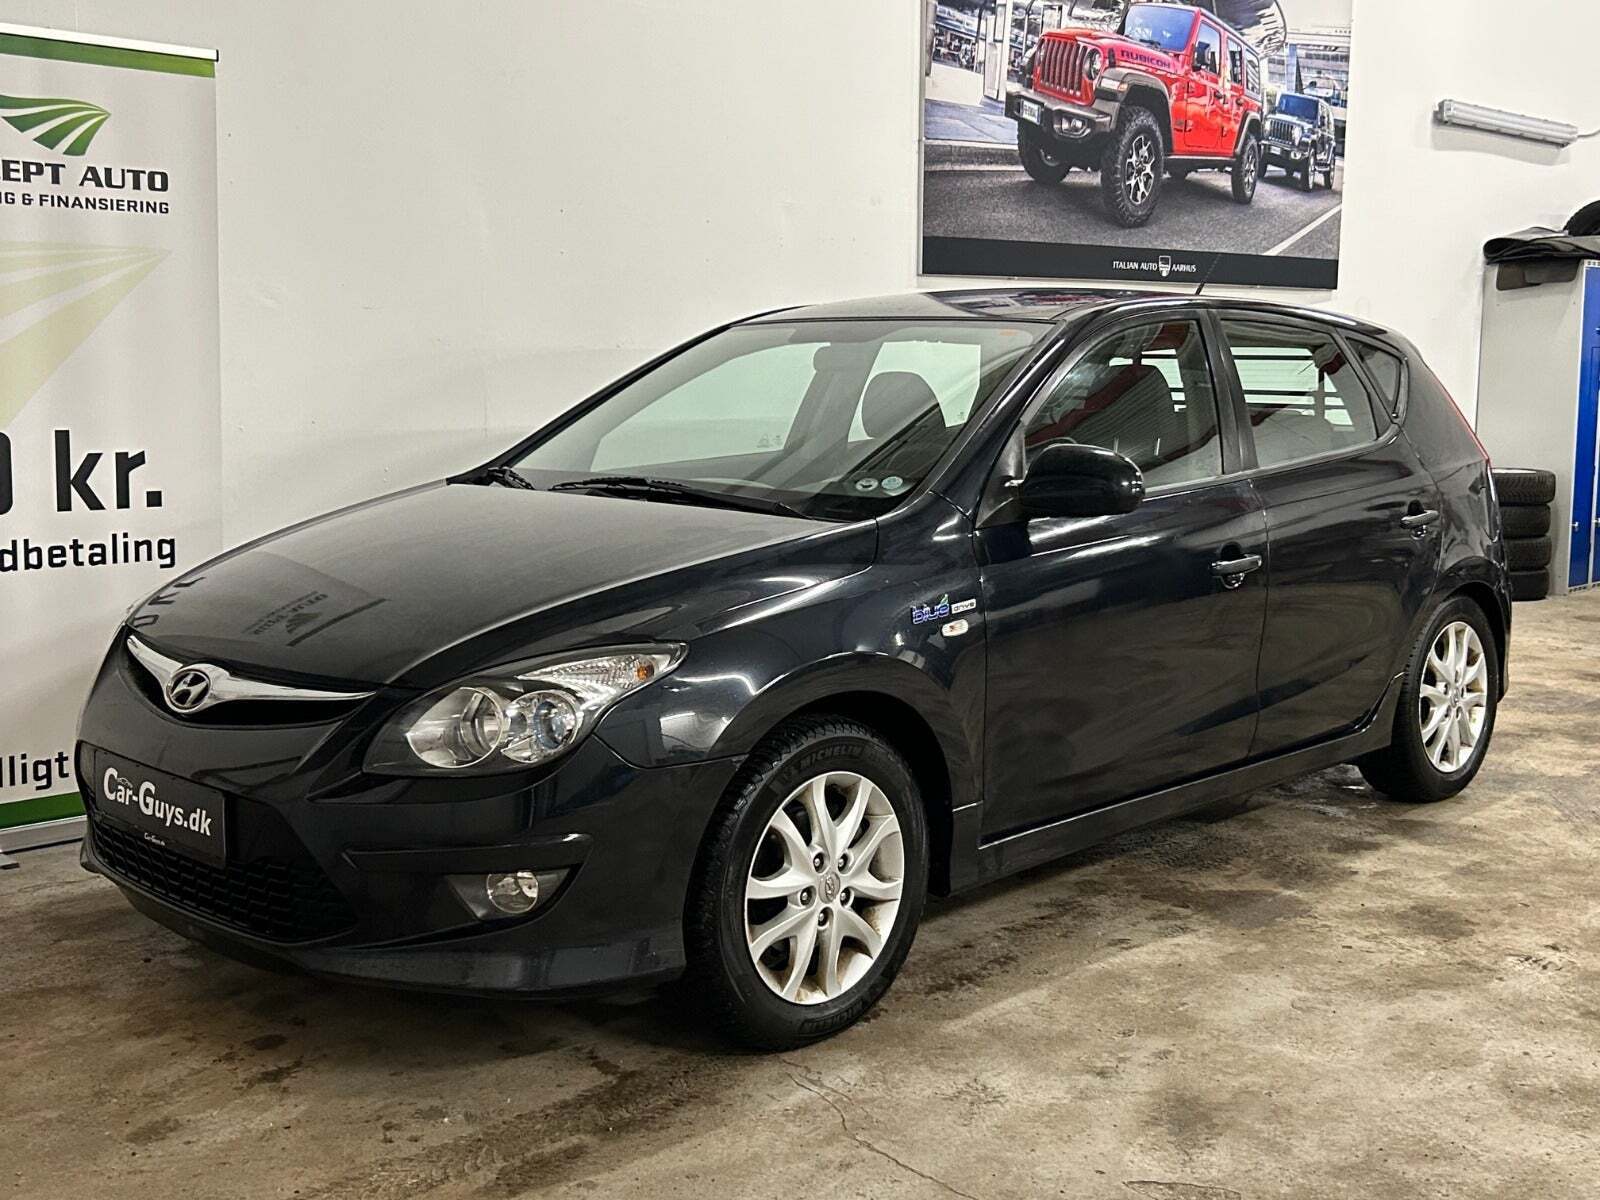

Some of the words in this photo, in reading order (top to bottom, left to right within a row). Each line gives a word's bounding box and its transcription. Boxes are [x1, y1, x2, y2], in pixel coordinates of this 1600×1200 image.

[0, 159, 66, 185] EPT
[79, 166, 169, 192] AUTO
[0, 191, 15, 205] G
[22, 193, 34, 206] &
[39, 194, 169, 214] FINANSIERING
[1112, 260, 1139, 270] ITALIAN
[1140, 261, 1158, 271] AUTO
[1171, 263, 1197, 272] AARHUS
[54, 429, 163, 513] kr.
[0, 532, 176, 573] dbetaling
[103, 767, 212, 837] Car-Guys.dk
